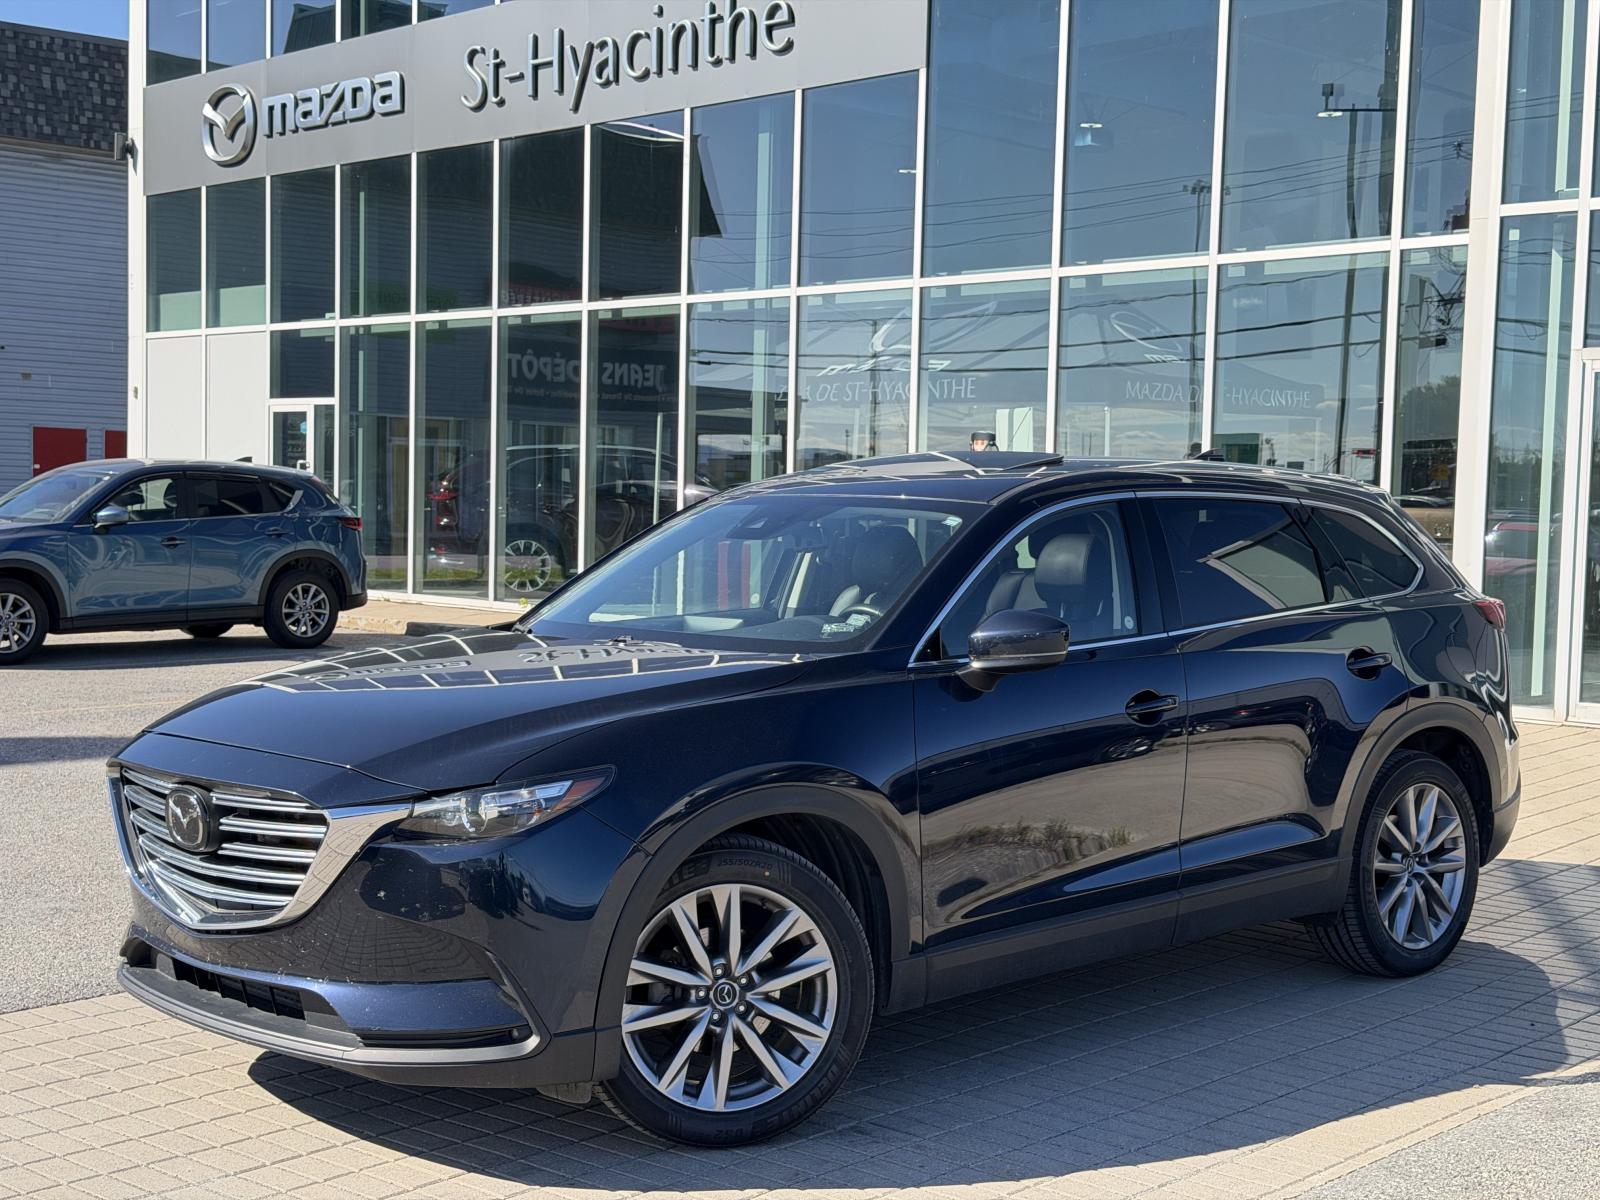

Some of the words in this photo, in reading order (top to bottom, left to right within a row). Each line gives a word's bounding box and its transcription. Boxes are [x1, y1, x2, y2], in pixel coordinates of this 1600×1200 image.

[262, 71, 404, 138] mazda
[461, 0, 795, 112] St-Hyacinthe
[845, 377, 976, 401] ST-HYACNTHE
[1126, 381, 1183, 402] MAZDA
